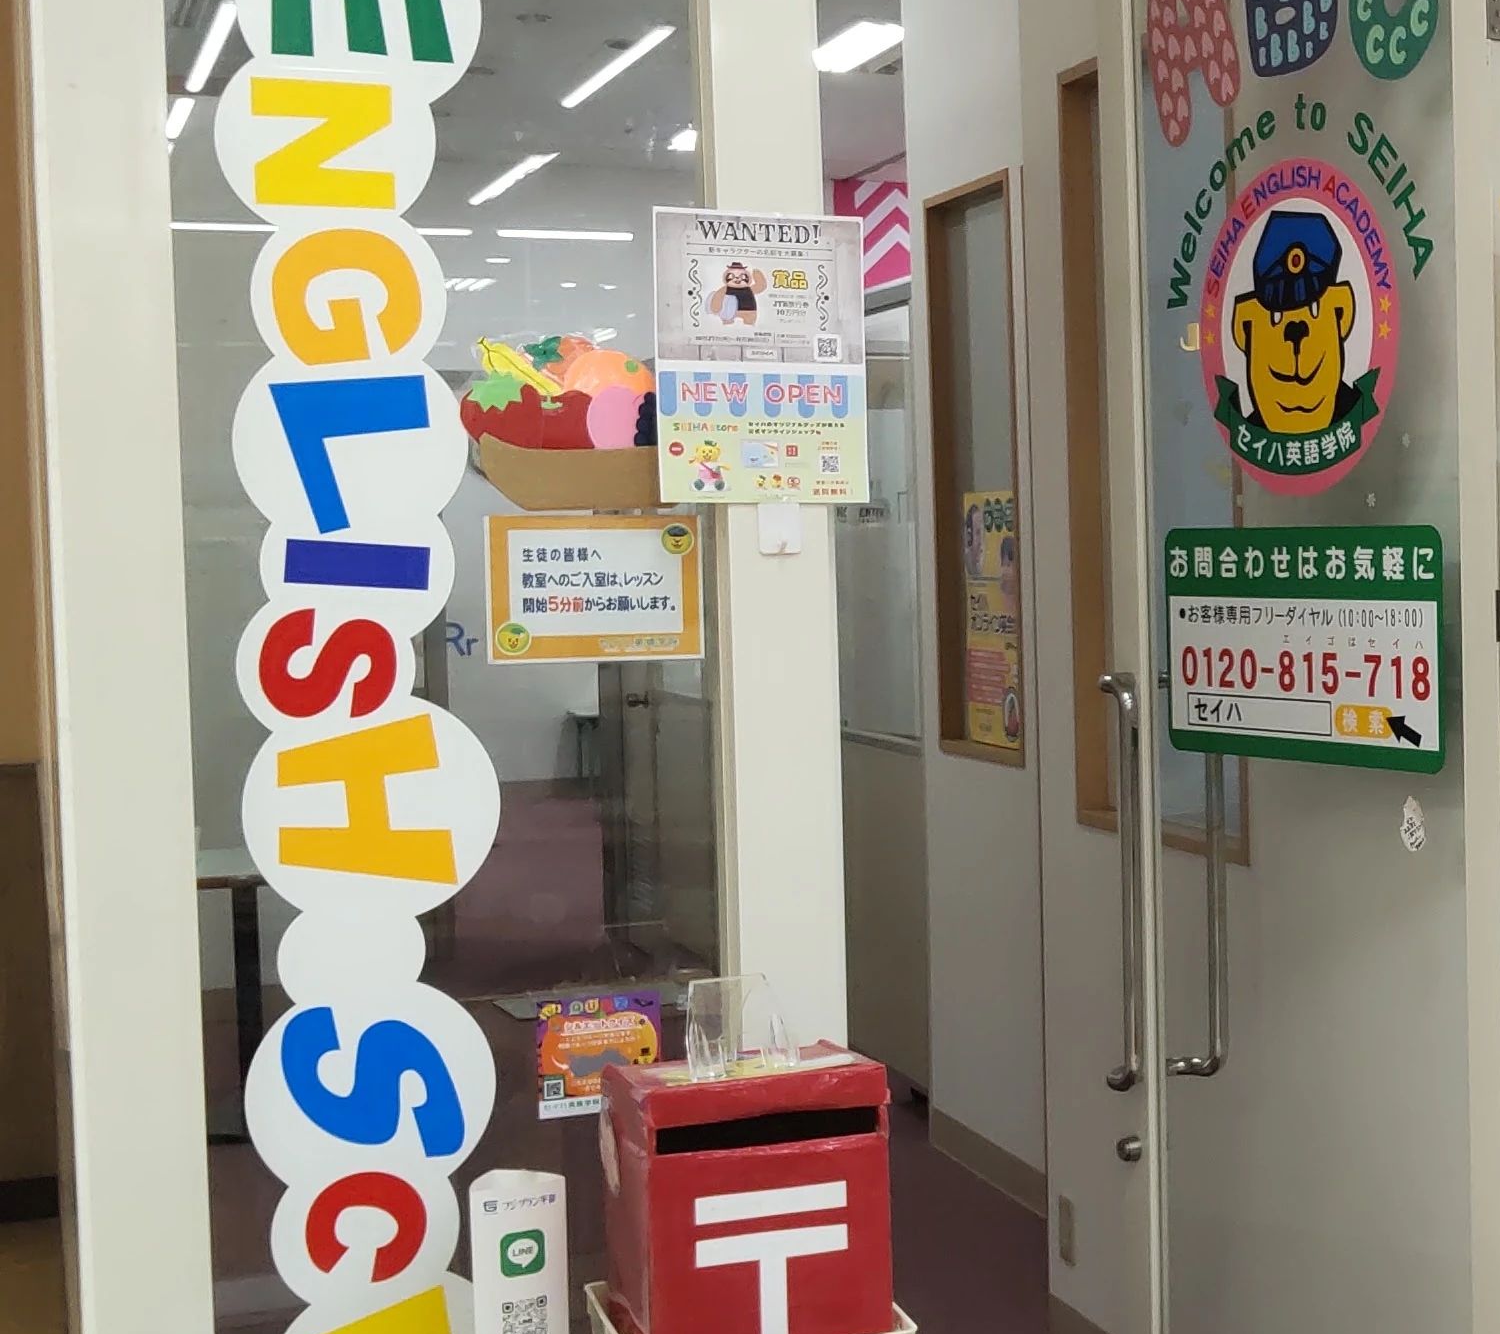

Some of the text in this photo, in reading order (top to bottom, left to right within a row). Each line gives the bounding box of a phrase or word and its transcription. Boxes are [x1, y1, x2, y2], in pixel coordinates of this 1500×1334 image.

[1166, 93, 1435, 310] Welcome to SEIHA
[697, 220, 821, 245] WANTED!
[1205, 165, 1392, 299] SEIHA ENGLISH ACADEMY
[772, 269, 808, 290] 賞品
[681, 382, 843, 404] NEW OPEN
[1237, 422, 1356, 467] セイハ英語学院
[522, 547, 602, 562] 生徒の皆様へ
[1169, 545, 1435, 581] お問合わせはお気軽に
[521, 571, 664, 589] 教室へのご入室は、レッスン
[521, 595, 677, 614] 開始5分前からお願いします。
[1187, 604, 1333, 627] お客様専用フリーダイヤル
[1181, 645, 1431, 701] 0120-815-718
[1193, 698, 1386, 736] セイハ 検索
[512, 1246, 534, 1257] LINE
